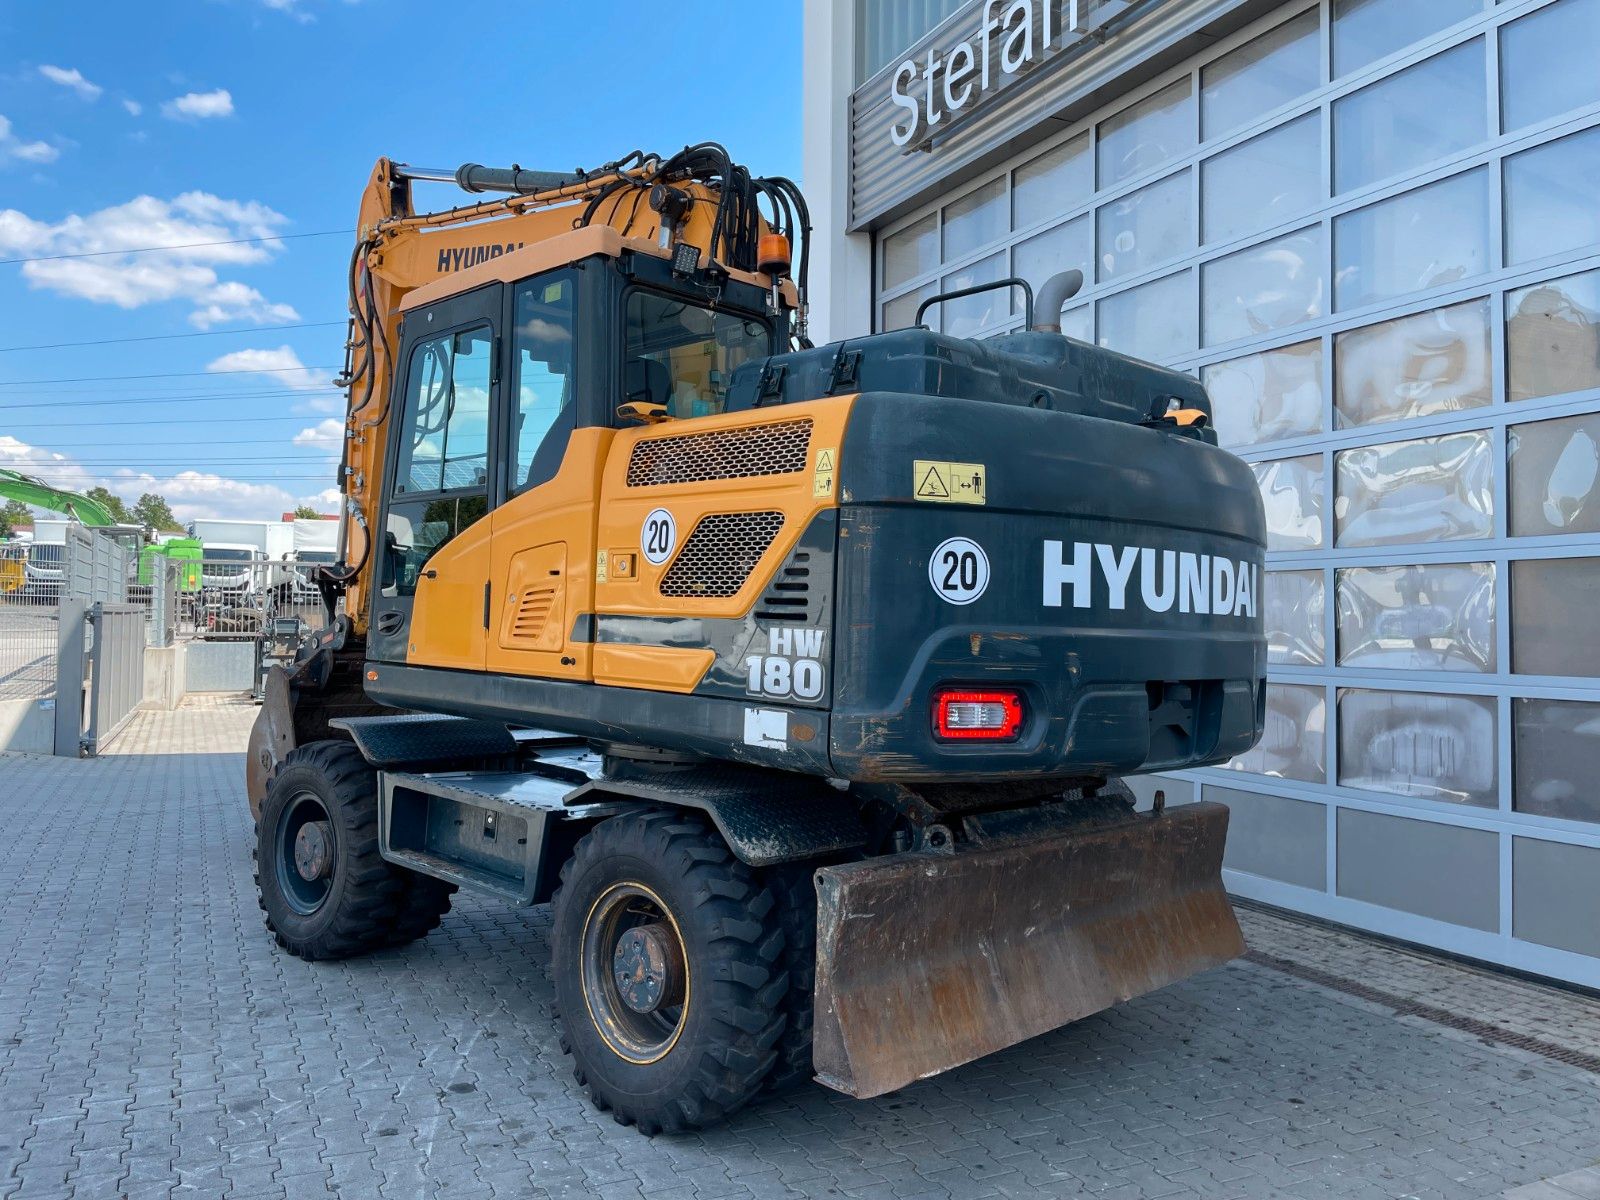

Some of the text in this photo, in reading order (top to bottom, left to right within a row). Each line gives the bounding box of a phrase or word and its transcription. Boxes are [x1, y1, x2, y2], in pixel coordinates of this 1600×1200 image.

[437, 242, 524, 272] HYUND
[648, 519, 670, 554] 20
[942, 550, 978, 591] 20
[1042, 539, 1257, 618] HYUNDAI
[769, 627, 825, 658] HW
[745, 655, 823, 699] 180
